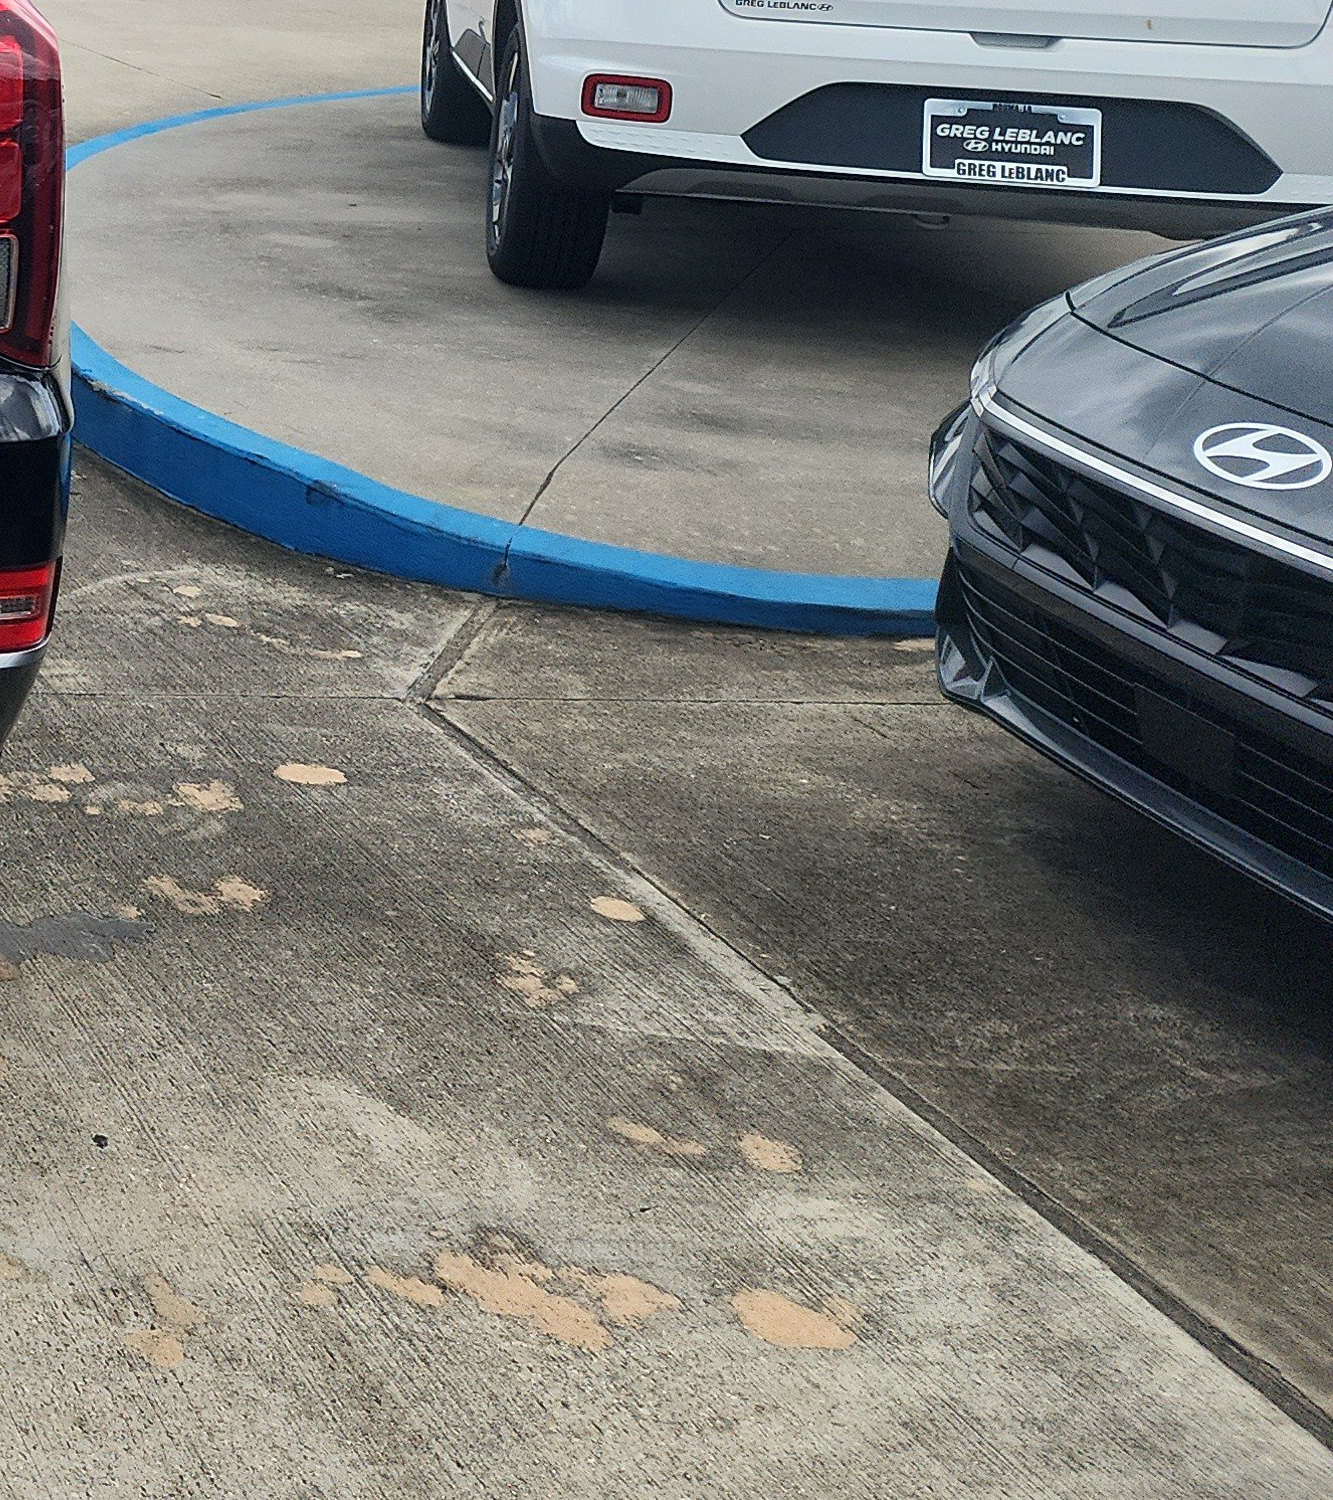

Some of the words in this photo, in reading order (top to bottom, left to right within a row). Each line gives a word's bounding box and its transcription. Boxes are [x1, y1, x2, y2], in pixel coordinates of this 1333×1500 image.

[735, 0, 765, 8] GREG
[936, 124, 989, 139] GREG
[992, 127, 1085, 146] LEBLANC
[991, 142, 1055, 156] HYUNDAI
[956, 161, 997, 178] GREG
